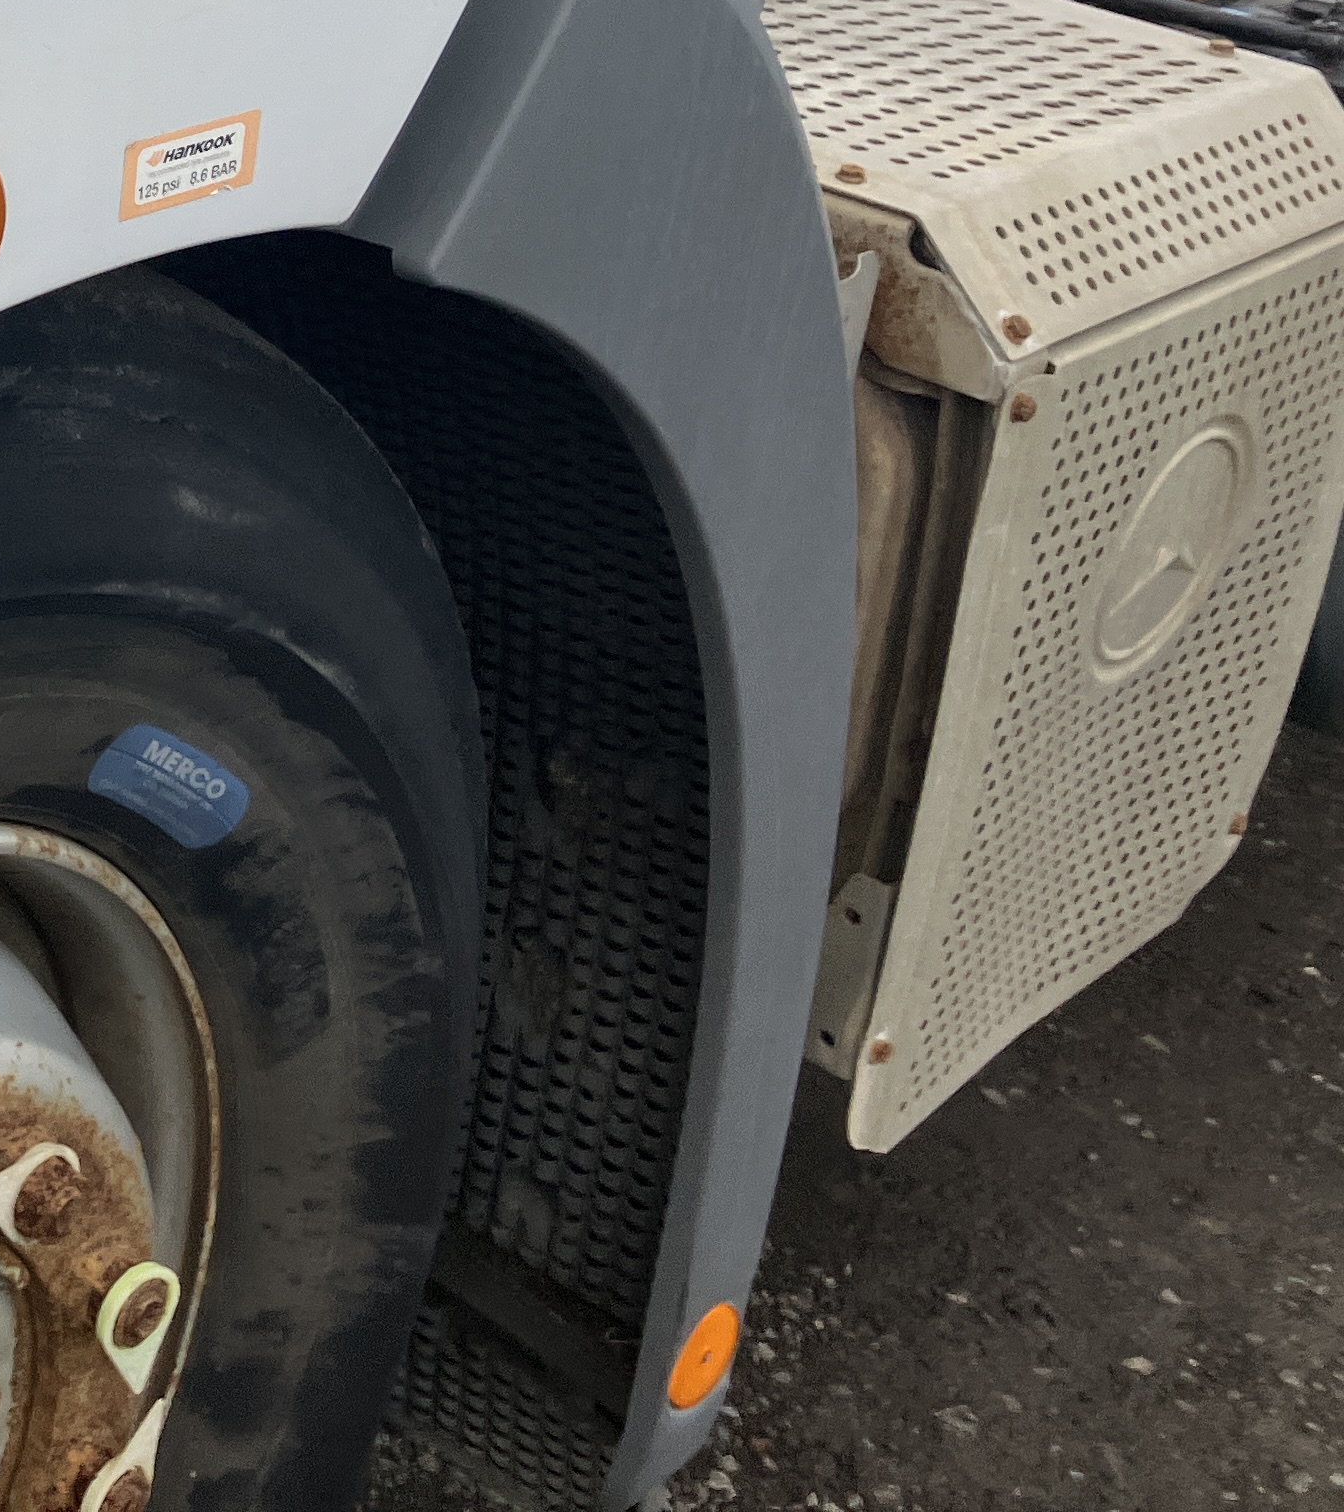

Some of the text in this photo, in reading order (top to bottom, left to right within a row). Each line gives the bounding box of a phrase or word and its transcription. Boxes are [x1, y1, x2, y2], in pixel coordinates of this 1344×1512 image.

[138, 183, 159, 200] 125
[162, 176, 181, 196] psi
[190, 169, 208, 185] 8.6
[212, 160, 237, 179] BAR
[142, 739, 226, 799] MERCO
